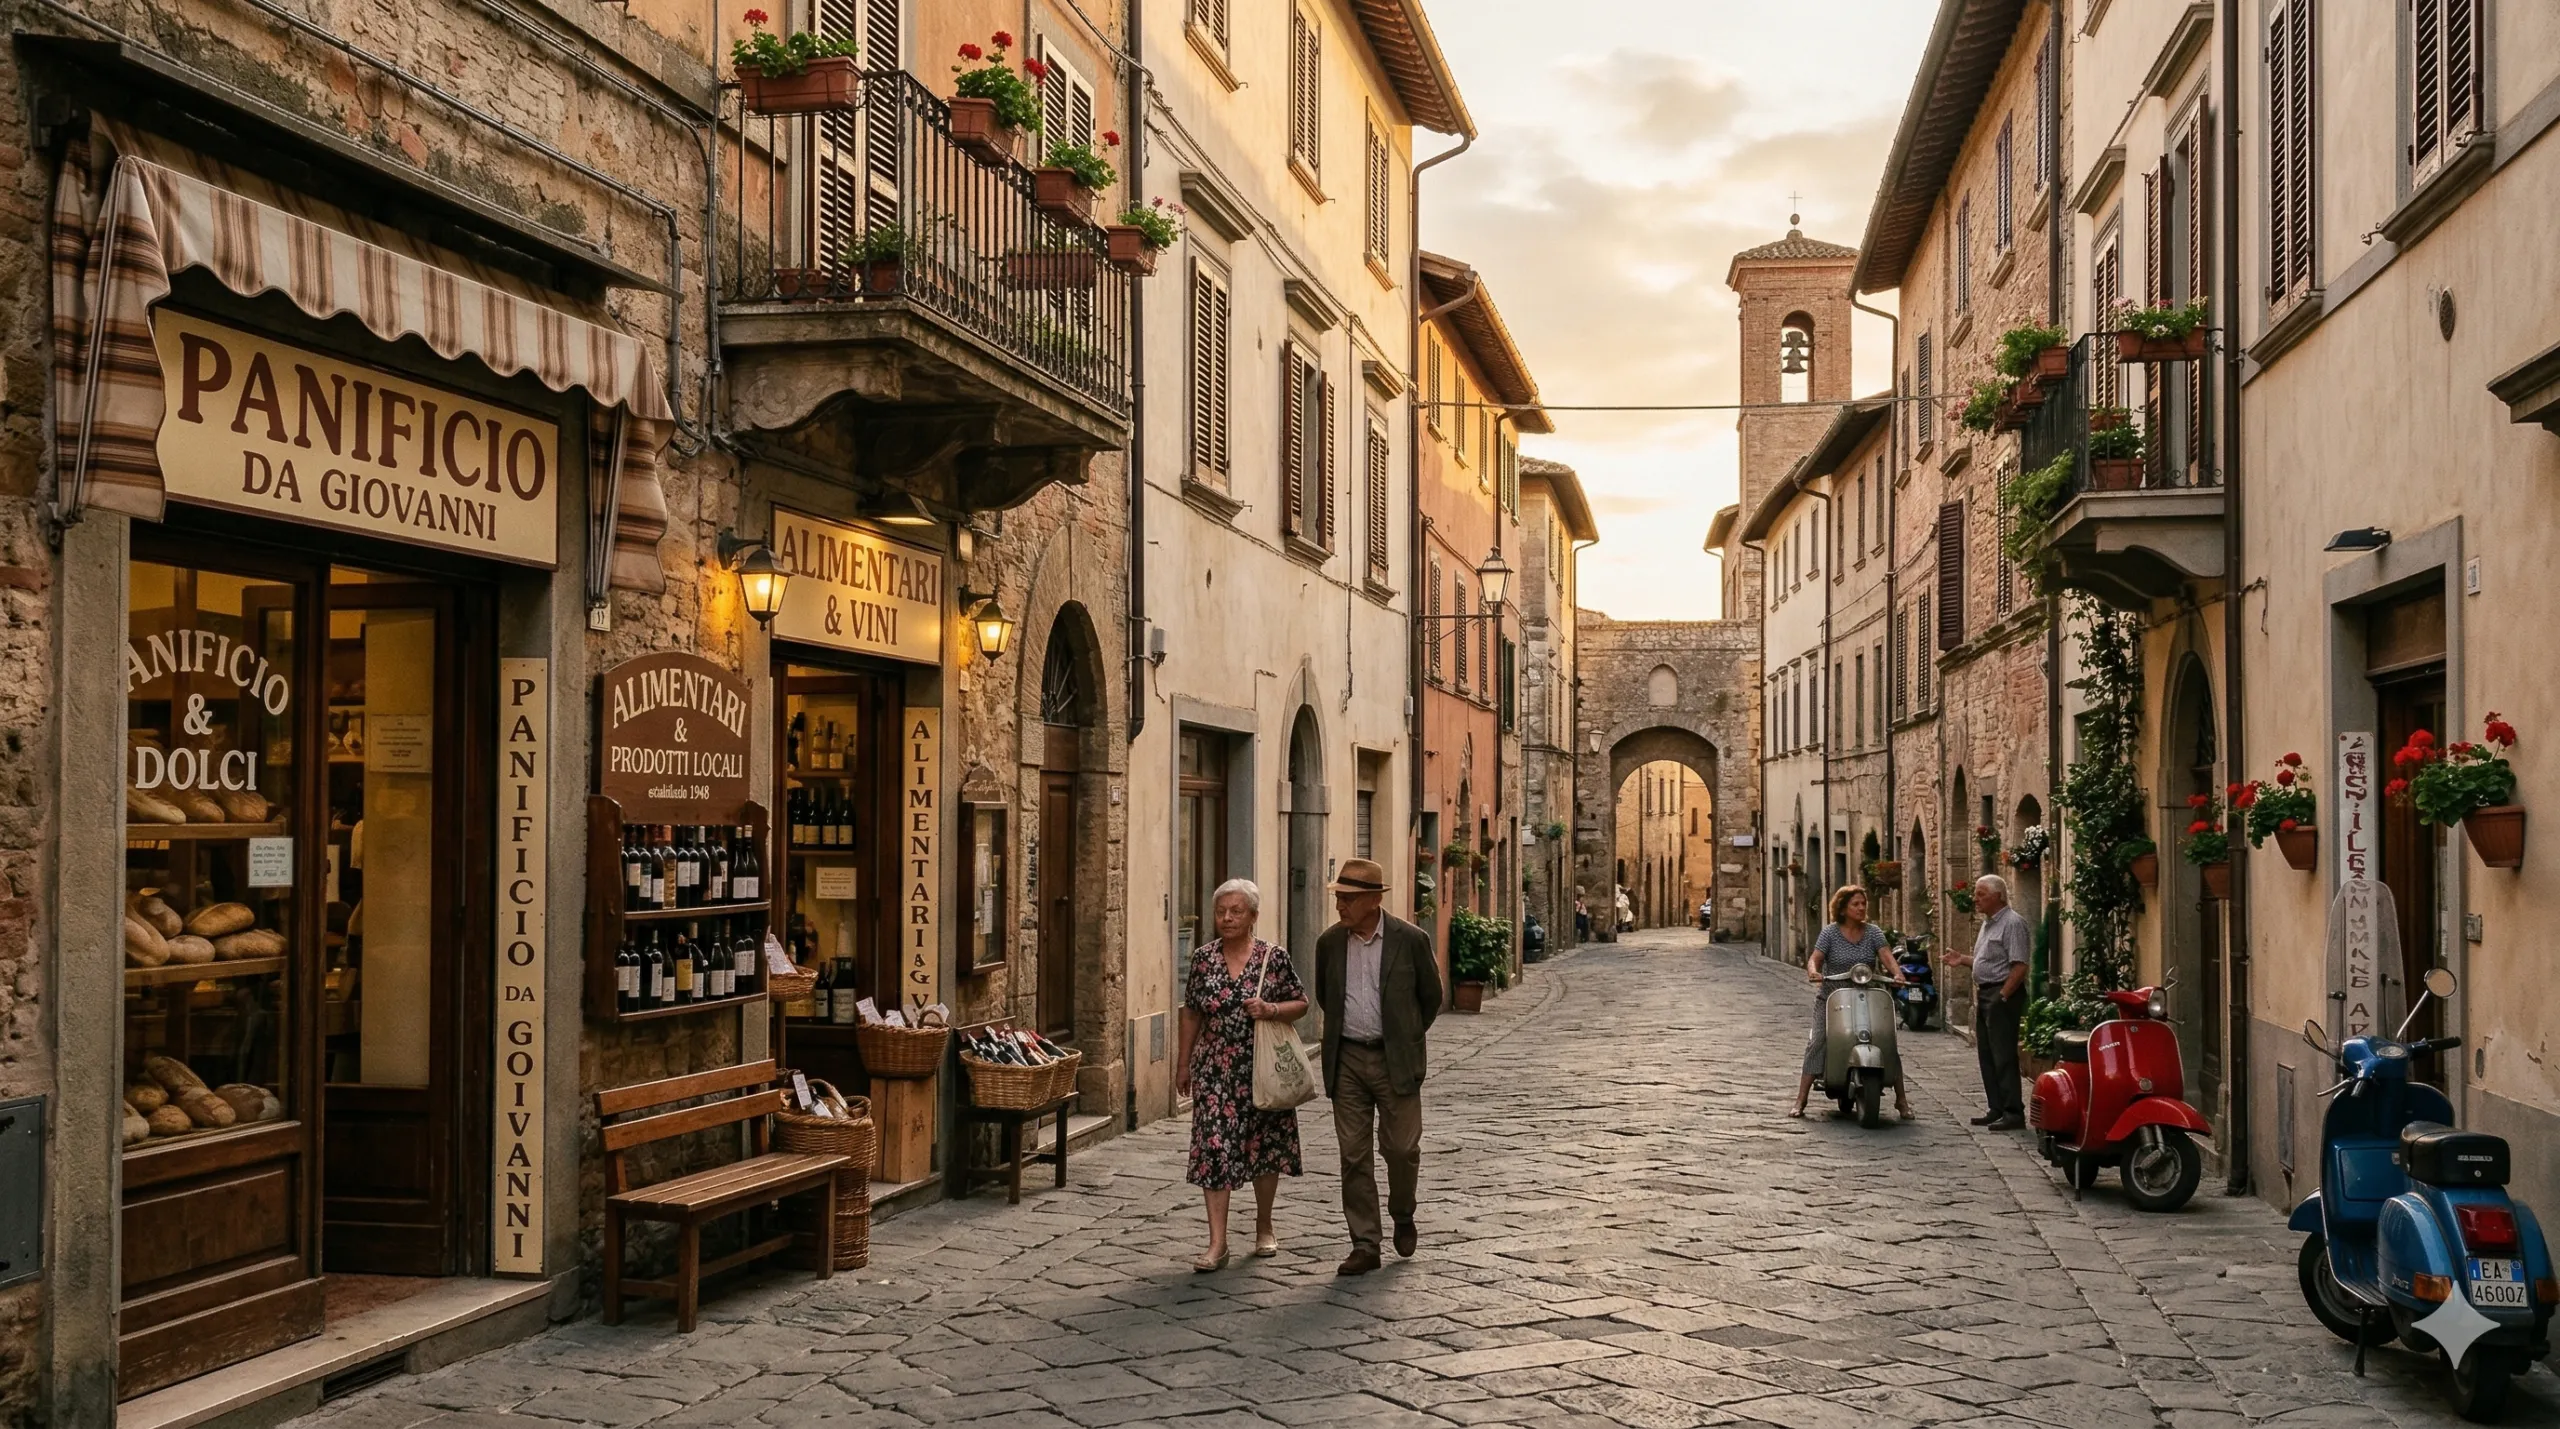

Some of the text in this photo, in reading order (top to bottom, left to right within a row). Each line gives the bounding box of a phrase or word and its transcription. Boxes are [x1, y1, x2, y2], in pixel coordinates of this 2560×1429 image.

[177, 331, 546, 501] PANIFICIO
[242, 449, 497, 541] DA GIOVANNI
[780, 525, 938, 606] ALIMENTARI
[824, 594, 898, 646] & VINI
[128, 629, 289, 716] ANIFICIO
[183, 693, 213, 735] &
[613, 668, 746, 739] ALIMENTARI
[674, 717, 687, 743] &
[135, 746, 257, 790] DOLCI
[611, 746, 743, 778] PRODOTTI LOCALI
[690, 784, 710, 800] 1948
[909, 720, 933, 948] ALIMENTARI
[505, 678, 537, 1258] PANIFICIO DA GOIVANNI
[2481, 1261, 2502, 1279] EA
